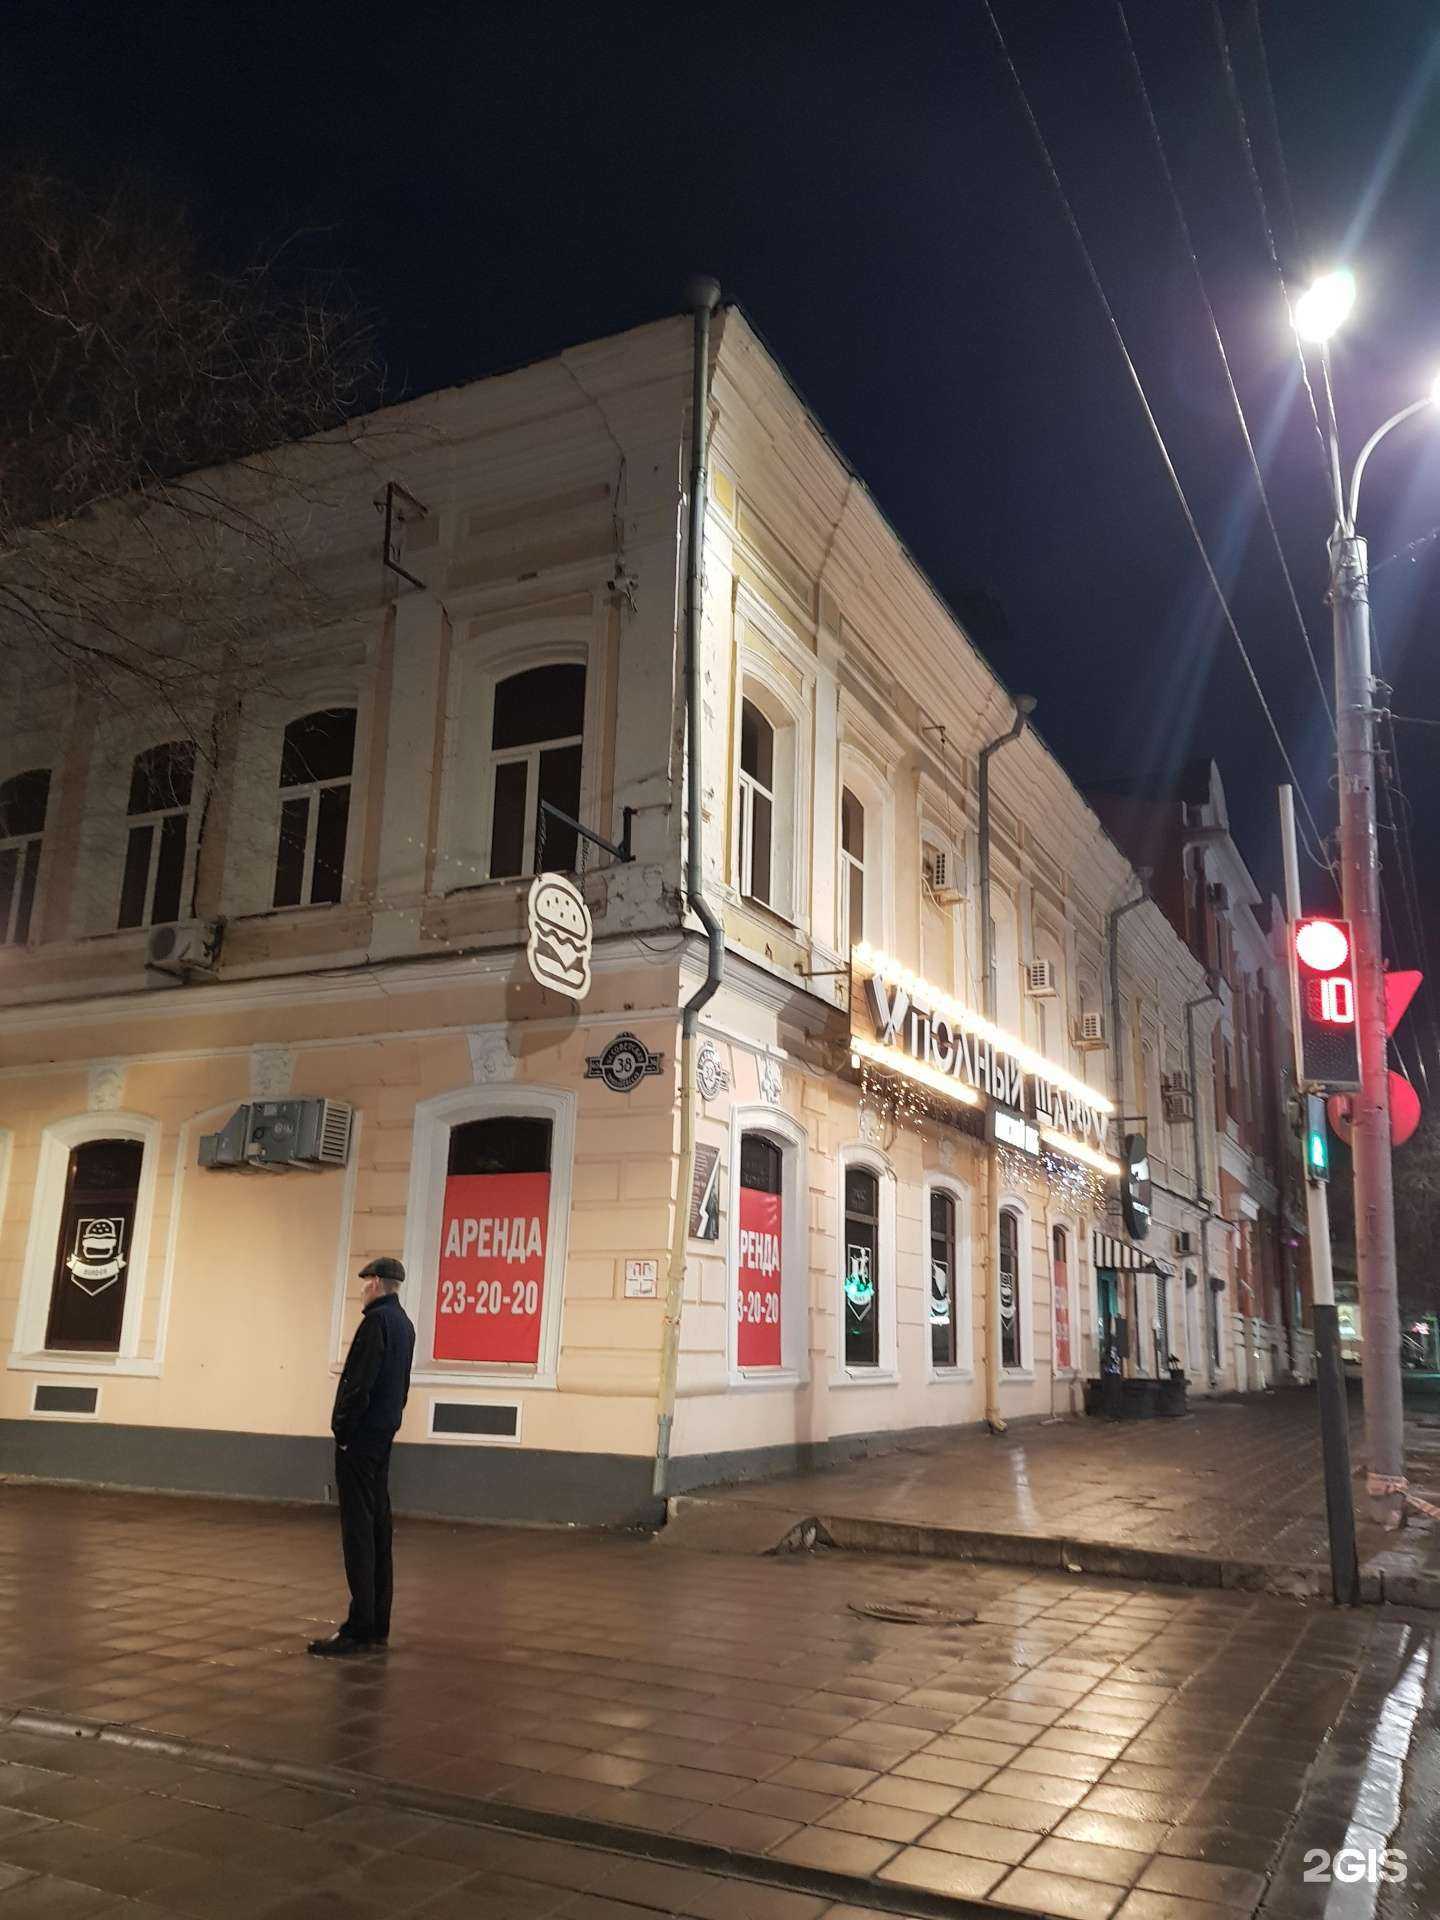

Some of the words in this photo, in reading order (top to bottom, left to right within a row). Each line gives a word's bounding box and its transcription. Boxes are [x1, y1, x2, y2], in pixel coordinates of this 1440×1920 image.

[1320, 976, 1355, 1024] 10
[614, 1057, 633, 1074] 38
[445, 1217, 543, 1264] АРЕНДА
[739, 1229, 781, 1278] РЕНДА
[440, 1280, 539, 1315] 23-20-20
[737, 1290, 780, 1323] 3-20-20
